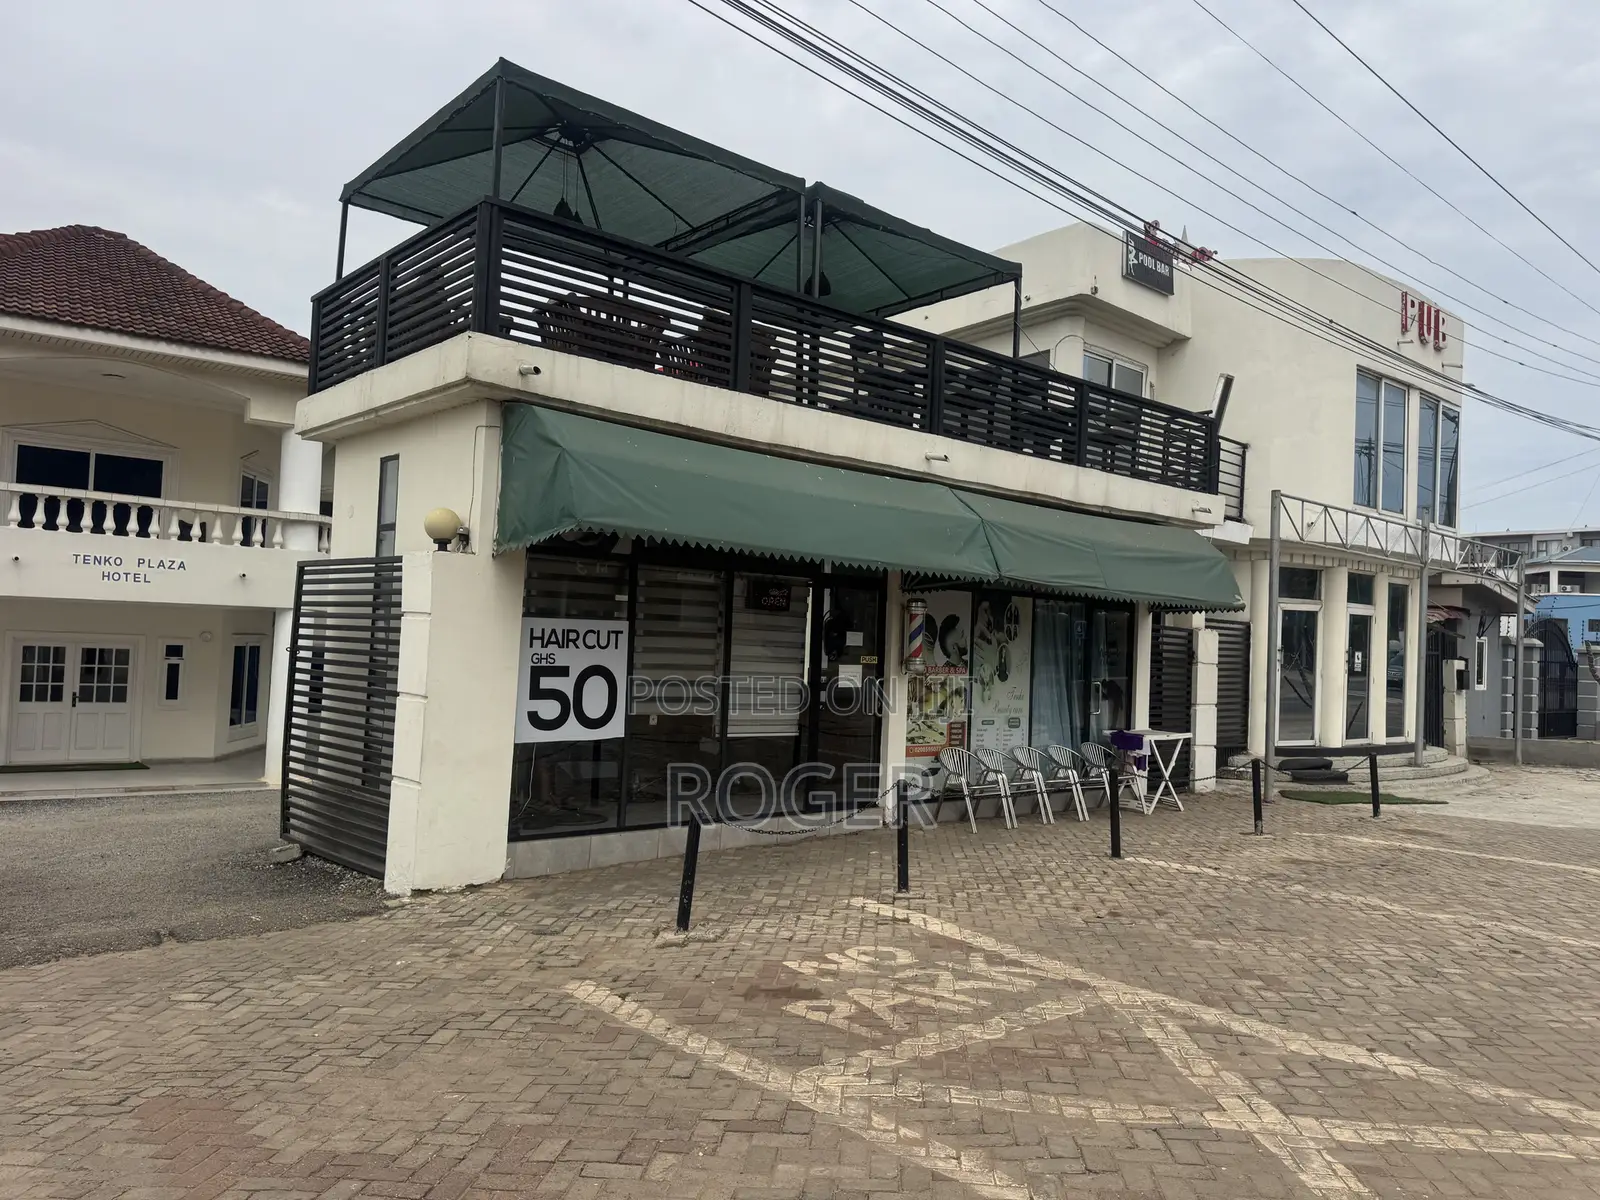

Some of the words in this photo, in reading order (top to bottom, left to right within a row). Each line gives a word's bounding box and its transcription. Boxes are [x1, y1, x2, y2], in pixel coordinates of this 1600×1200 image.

[1138, 252, 1156, 270] POOL
[1156, 260, 1170, 277] BAR
[1401, 291, 1448, 351] PUB
[72, 553, 123, 567] TENKO
[137, 558, 187, 571] PLAZA
[101, 571, 151, 583] HOTEL
[530, 652, 556, 665] GHS
[928, 666, 950, 674] BARBER
[526, 664, 618, 731] 50
